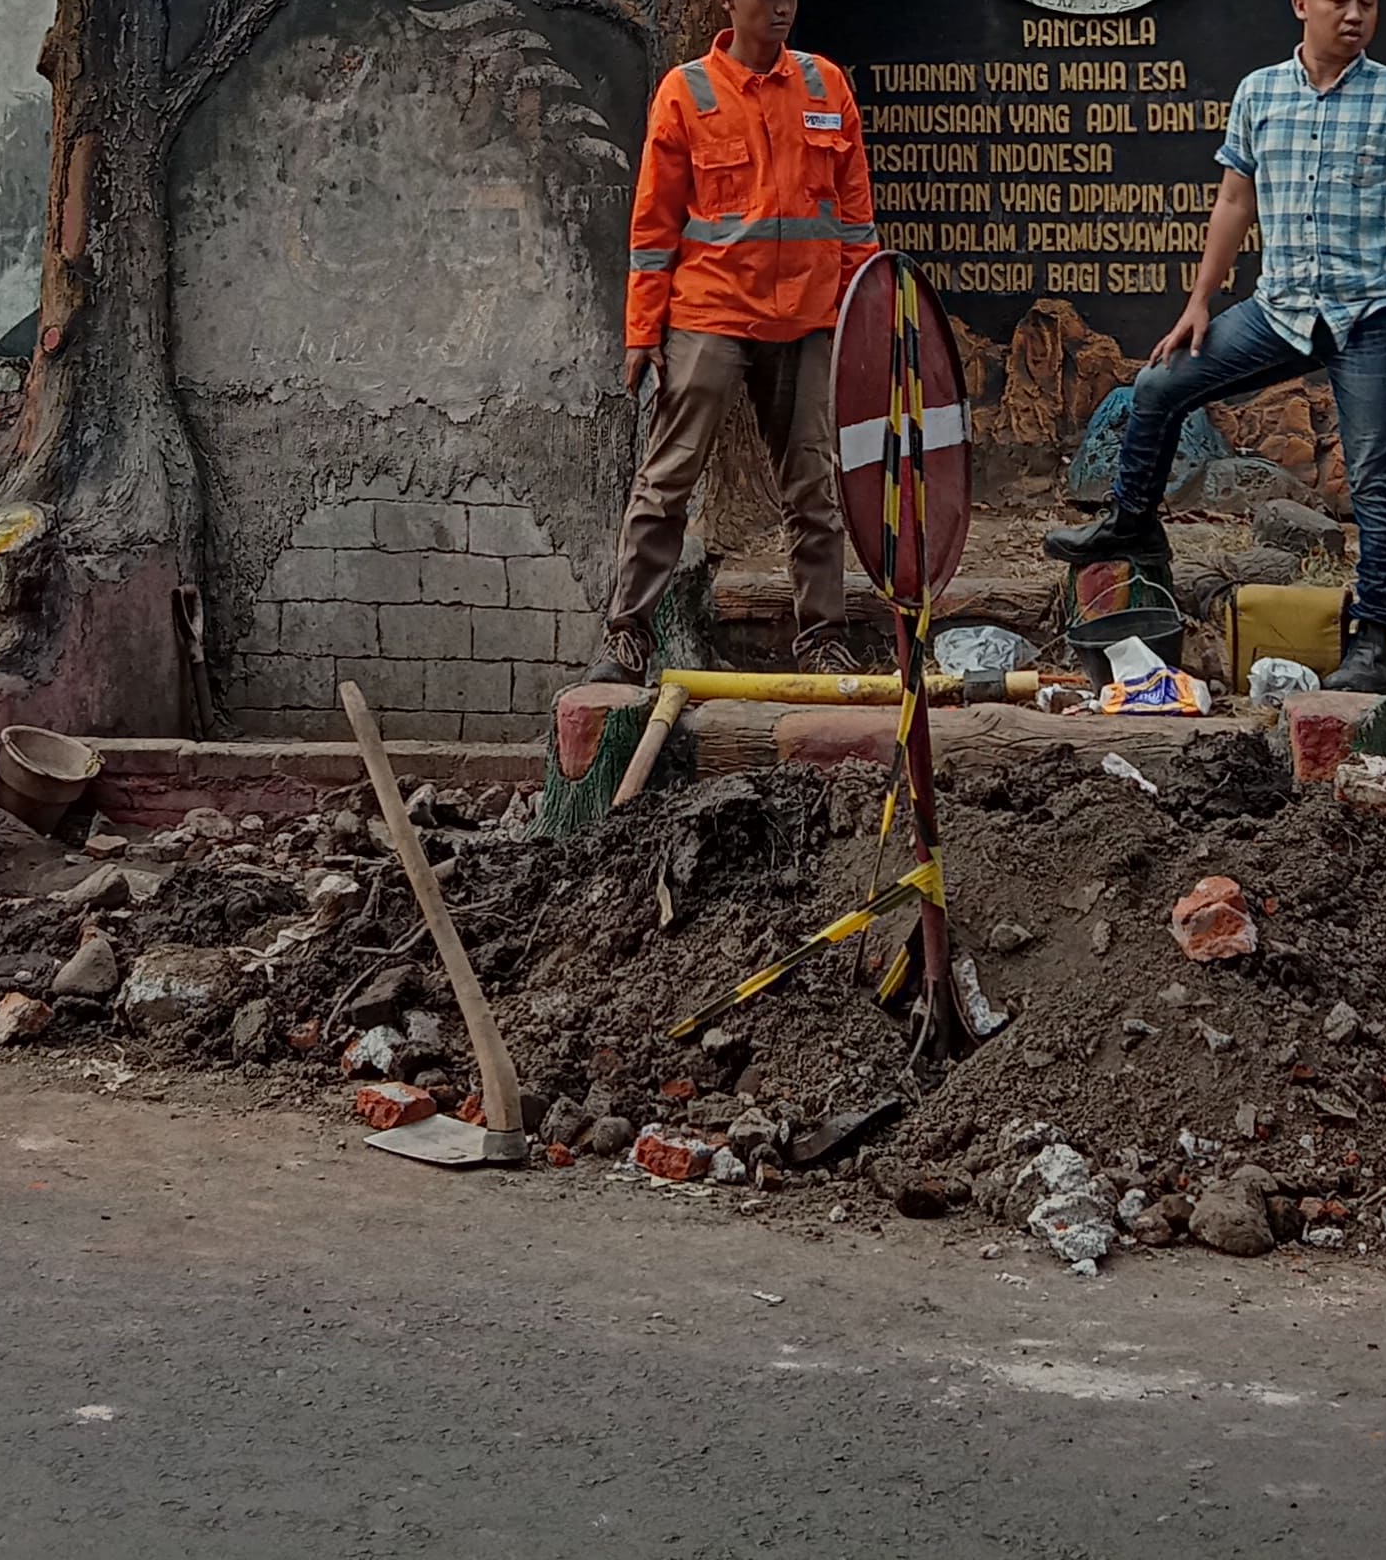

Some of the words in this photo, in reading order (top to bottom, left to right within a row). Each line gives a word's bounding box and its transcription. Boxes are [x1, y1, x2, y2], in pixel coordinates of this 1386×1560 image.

[1023, 17, 1156, 47] PANCASILA
[870, 64, 976, 93] TUHANAN
[984, 62, 1049, 92] YANG
[1059, 61, 1127, 91] MAHA
[1138, 60, 1187, 90] ESA
[1009, 104, 1071, 134] YANG
[1086, 103, 1138, 133] ADIL
[1147, 102, 1195, 132] DAN
[990, 143, 1113, 173] INDONESIA
[1001, 182, 1062, 213] YANG
[1069, 183, 1163, 213] DIPIMPIN
[941, 223, 1016, 252] DALAM
[1048, 263, 1099, 292] BAGI
